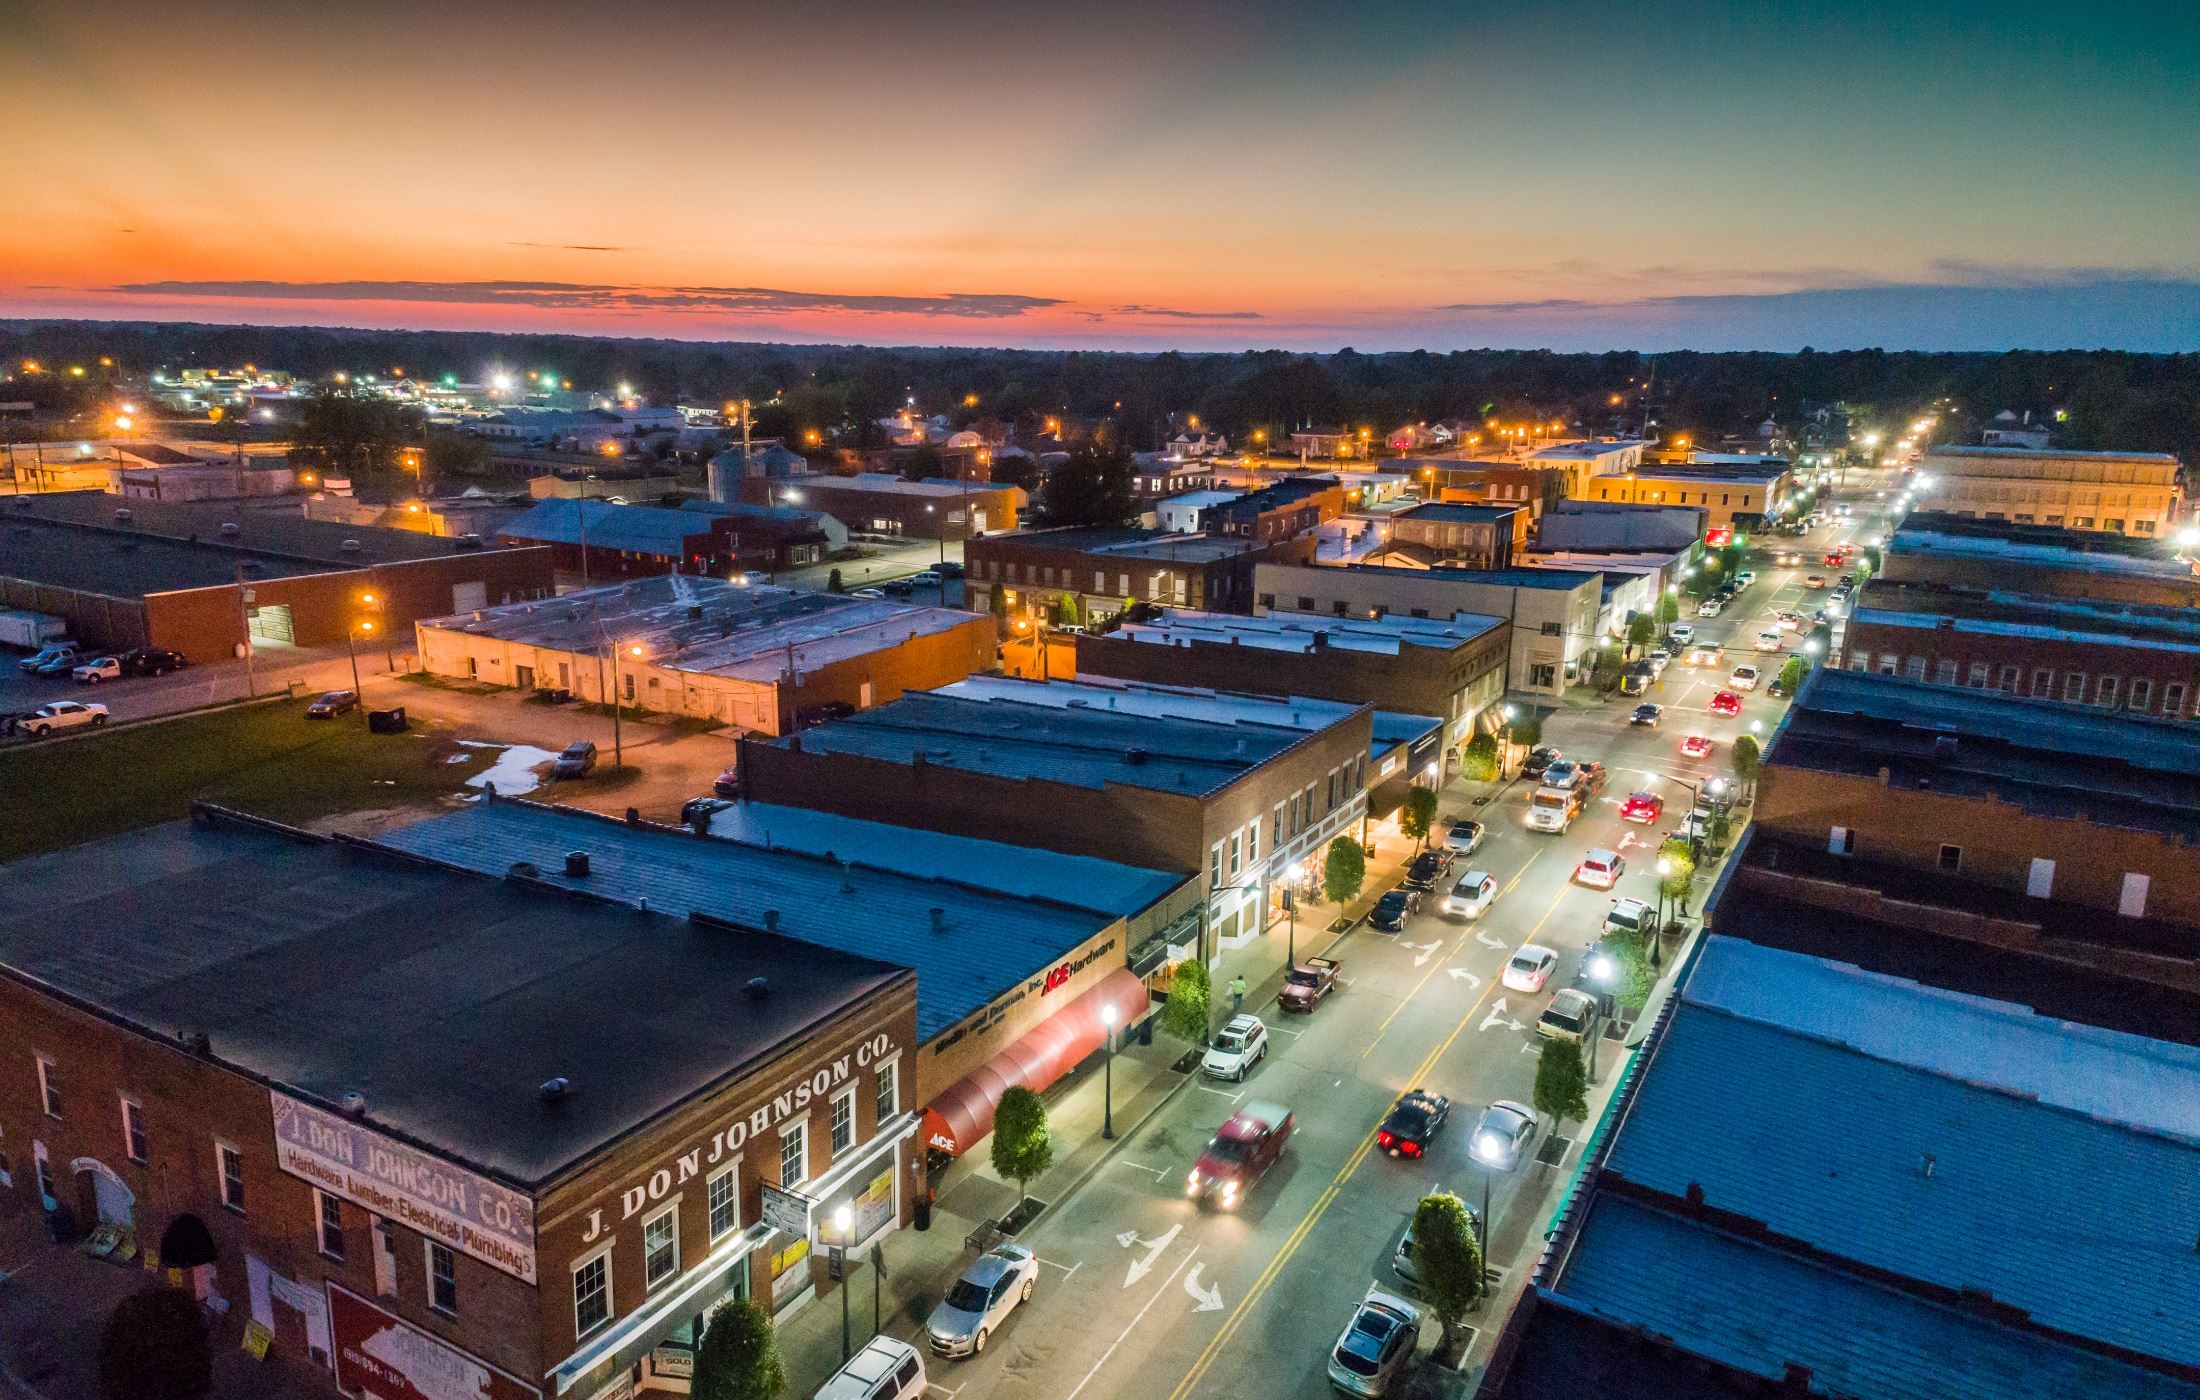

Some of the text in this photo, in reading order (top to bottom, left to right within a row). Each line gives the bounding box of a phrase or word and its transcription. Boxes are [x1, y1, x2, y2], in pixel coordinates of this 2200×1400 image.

[1040, 939, 1116, 998] ACE Hardware
[582, 1209, 611, 1243] J.
[620, 1147, 701, 1221] DON
[707, 1054, 850, 1163] JOHNSON
[856, 1032, 895, 1067] CO.
[929, 1132, 955, 1151] ACE
[287, 1149, 344, 1189] Hardware
[309, 1119, 353, 1164] DON
[367, 1145, 466, 1214] JOHNSON
[478, 1192, 518, 1235] CO.
